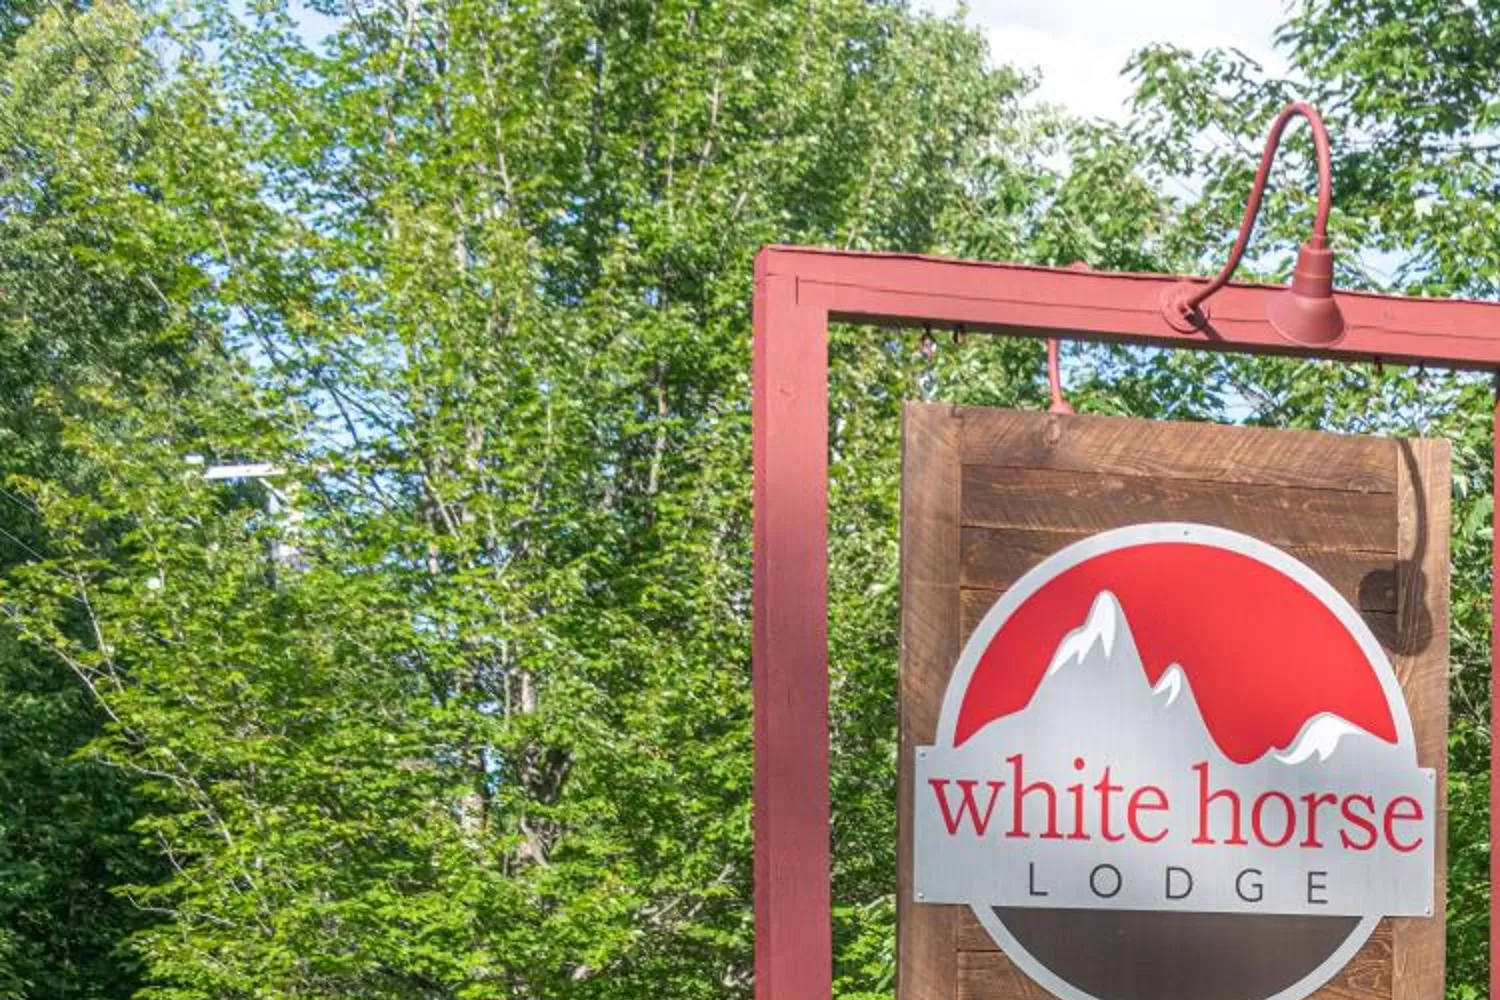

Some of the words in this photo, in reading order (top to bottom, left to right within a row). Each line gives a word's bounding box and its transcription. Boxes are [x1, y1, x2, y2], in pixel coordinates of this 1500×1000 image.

[928, 753, 1169, 843] white
[1192, 762, 1424, 852] horse
[1027, 862, 1329, 904] LODGE
